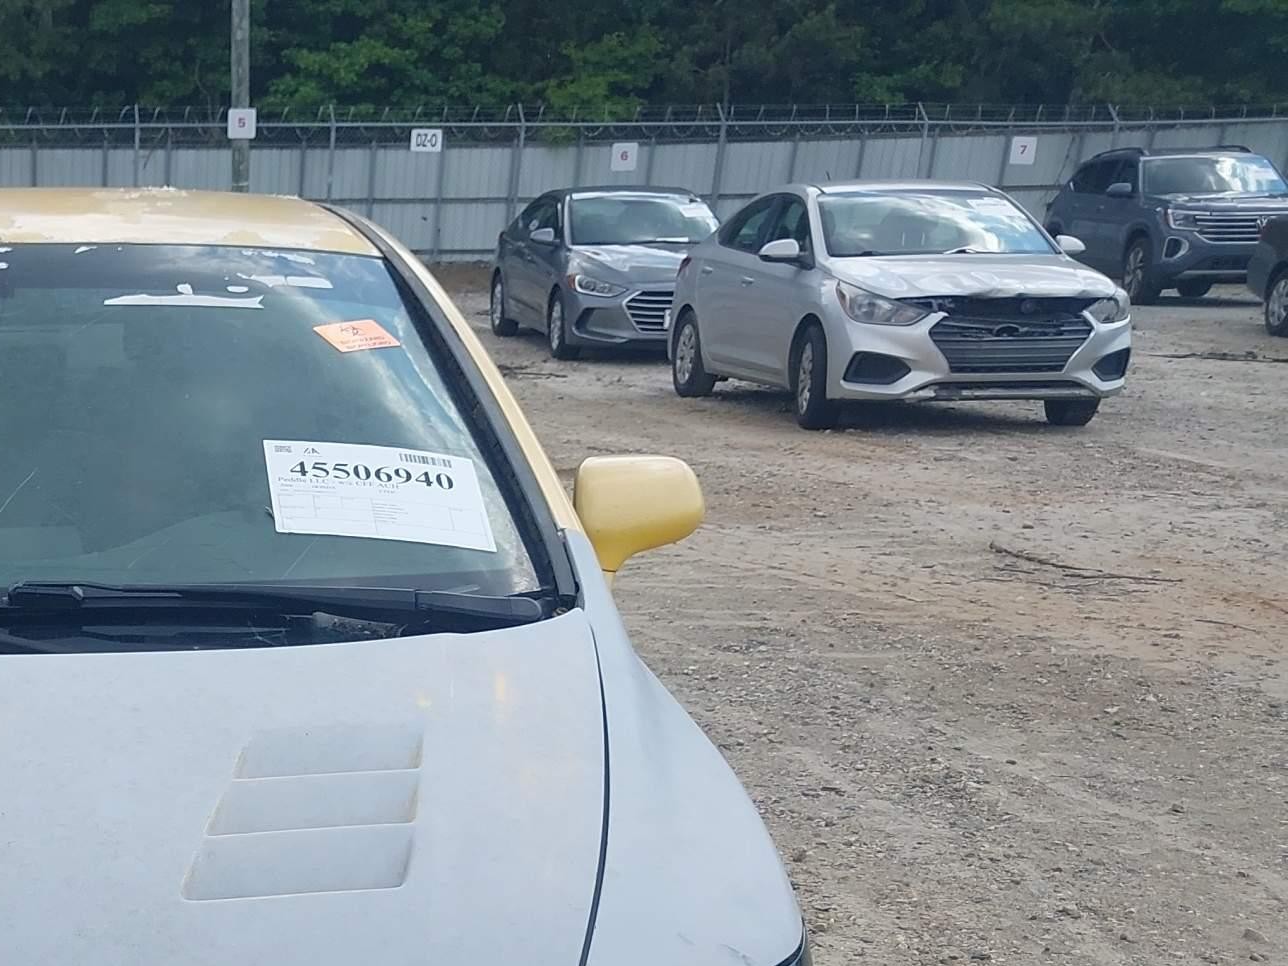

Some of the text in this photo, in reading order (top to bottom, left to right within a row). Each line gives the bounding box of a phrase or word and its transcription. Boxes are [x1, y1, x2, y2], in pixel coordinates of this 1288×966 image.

[237, 117, 247, 129] 5
[1019, 144, 1028, 155] 7
[620, 150, 629, 161] 6
[290, 460, 454, 490] 45506940
